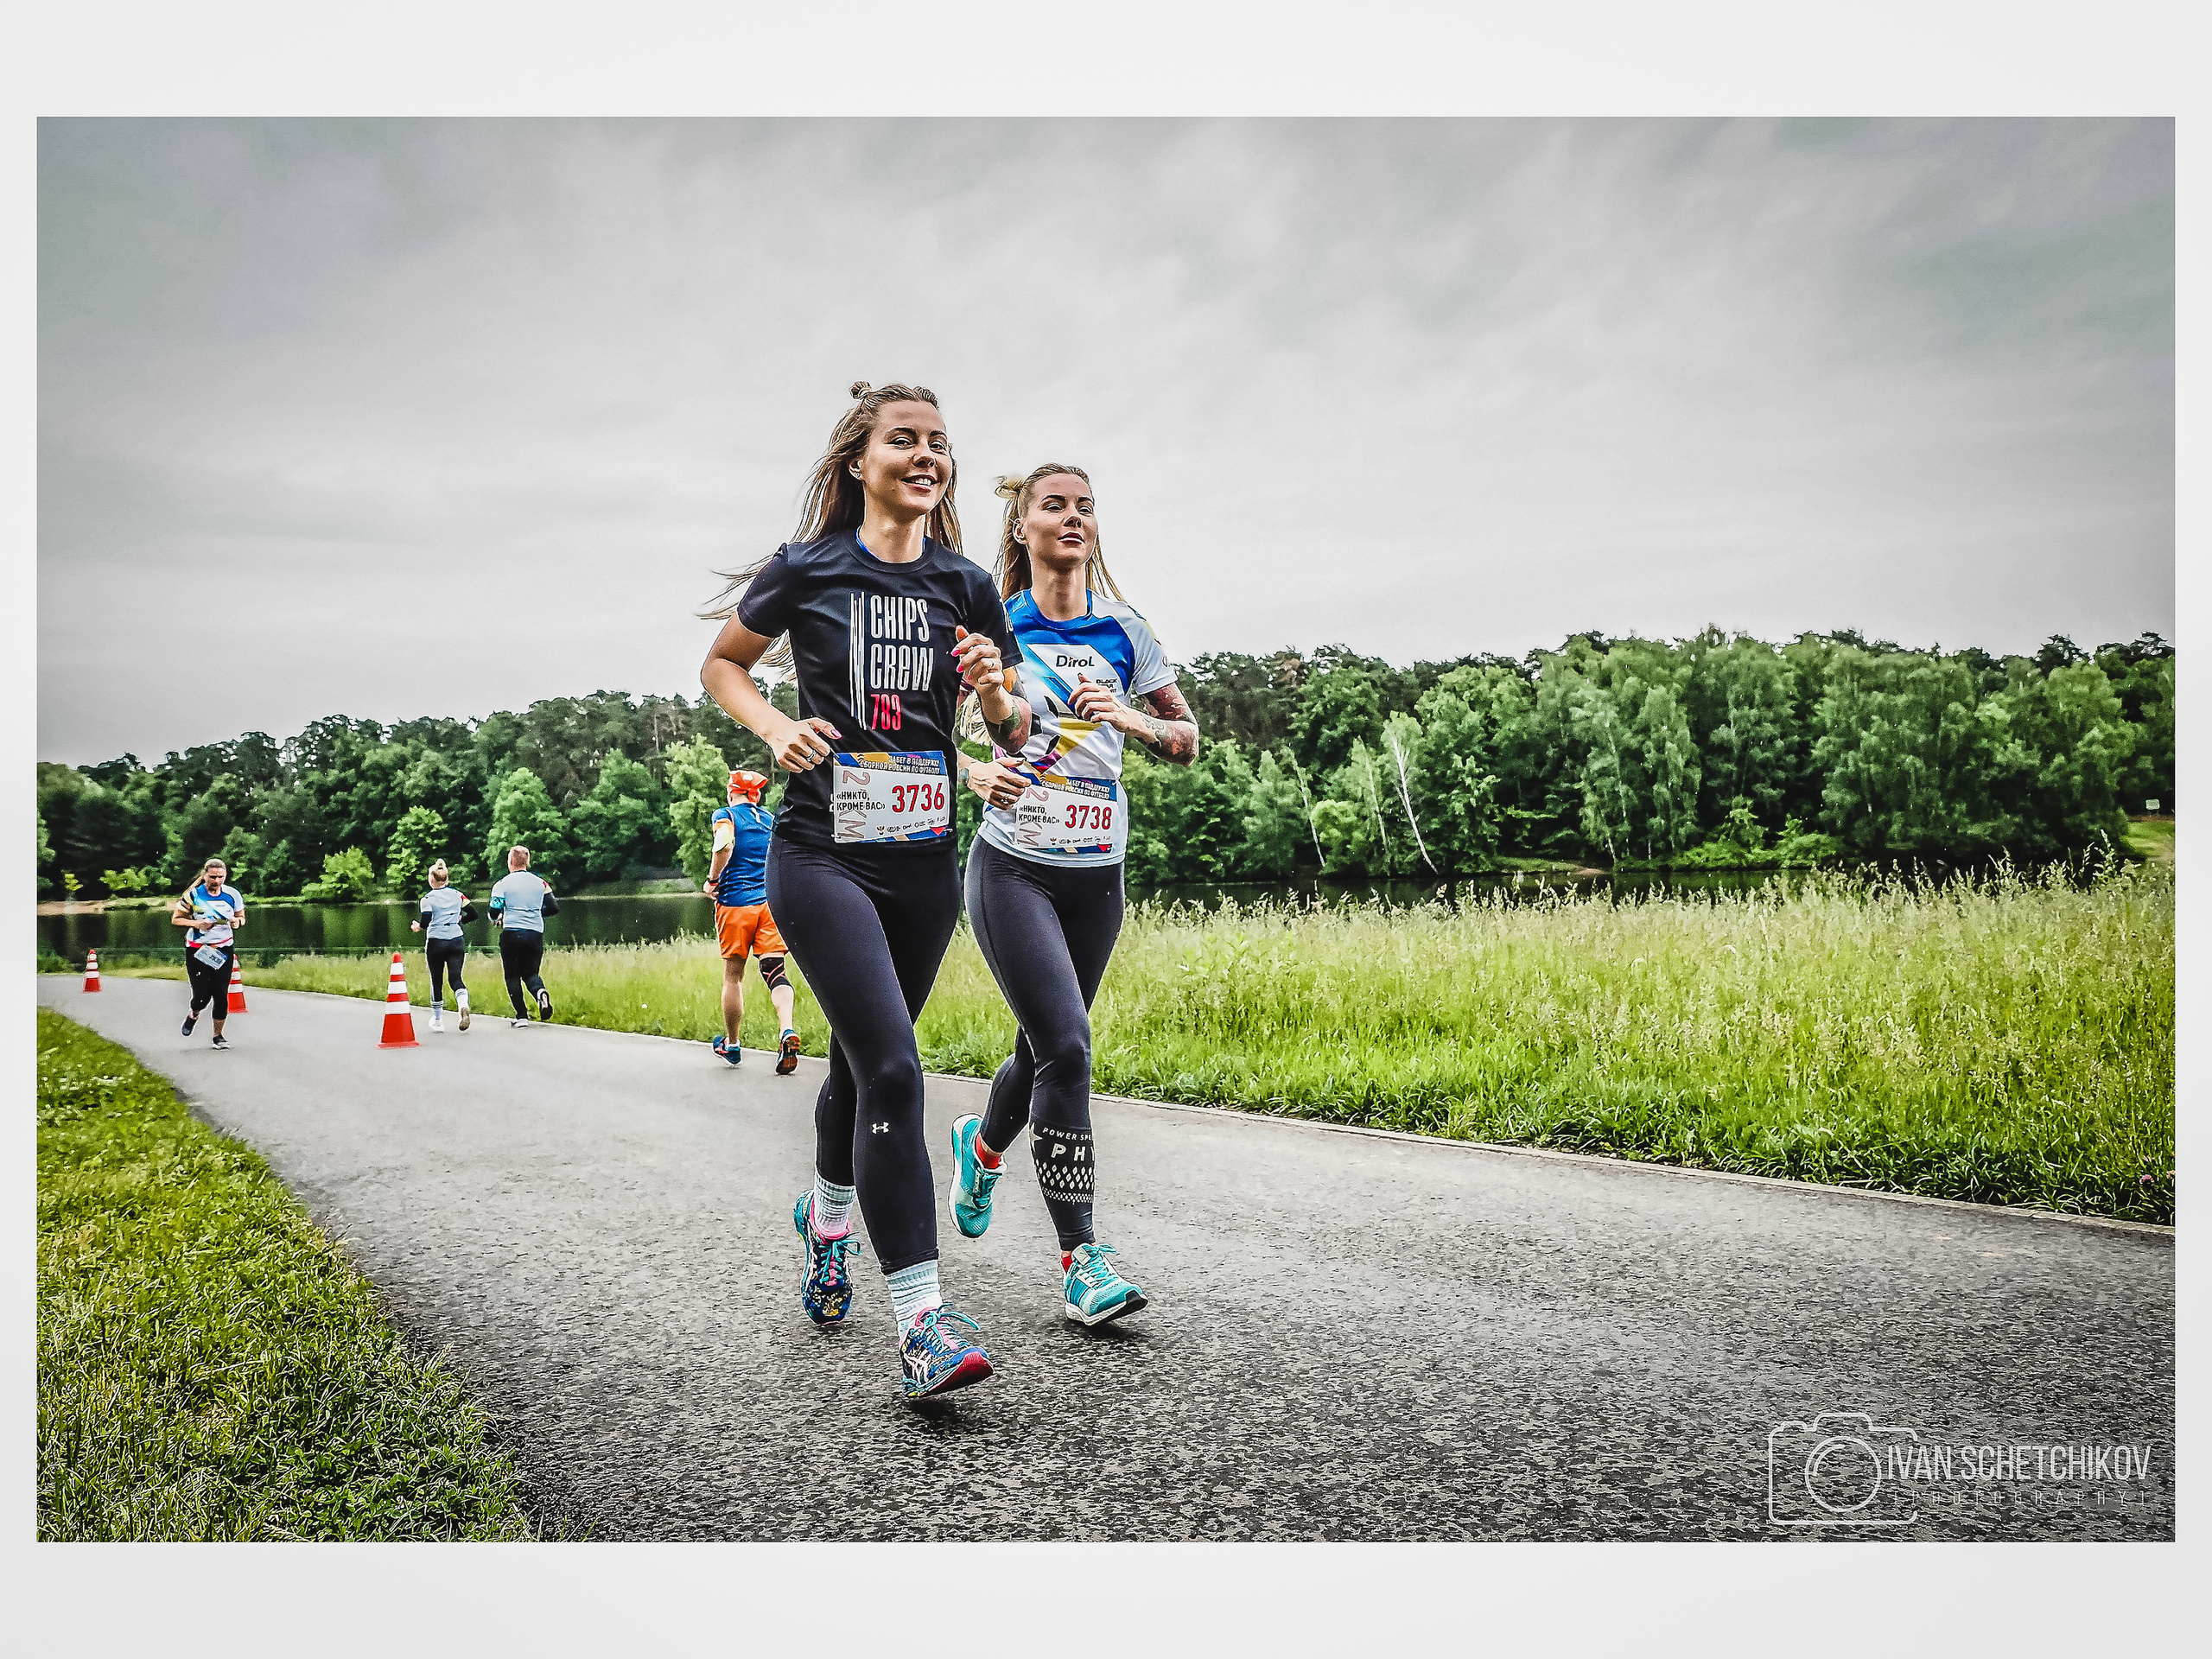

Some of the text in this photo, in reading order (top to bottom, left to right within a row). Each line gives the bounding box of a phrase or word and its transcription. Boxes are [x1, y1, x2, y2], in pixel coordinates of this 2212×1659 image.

[870, 594, 930, 642] CHIPS
[870, 694, 901, 731] 783
[836, 791, 870, 801] «НИКТО,
[892, 783, 944, 813] 3736
[836, 801, 886, 810] КРОМЕ ВАС»
[1019, 804, 1046, 815] «НИКТО,
[1019, 814, 1060, 824] КРОМЕ ВАС»
[1065, 804, 1112, 830] 3738
[1042, 1127, 1077, 1141] POWER
